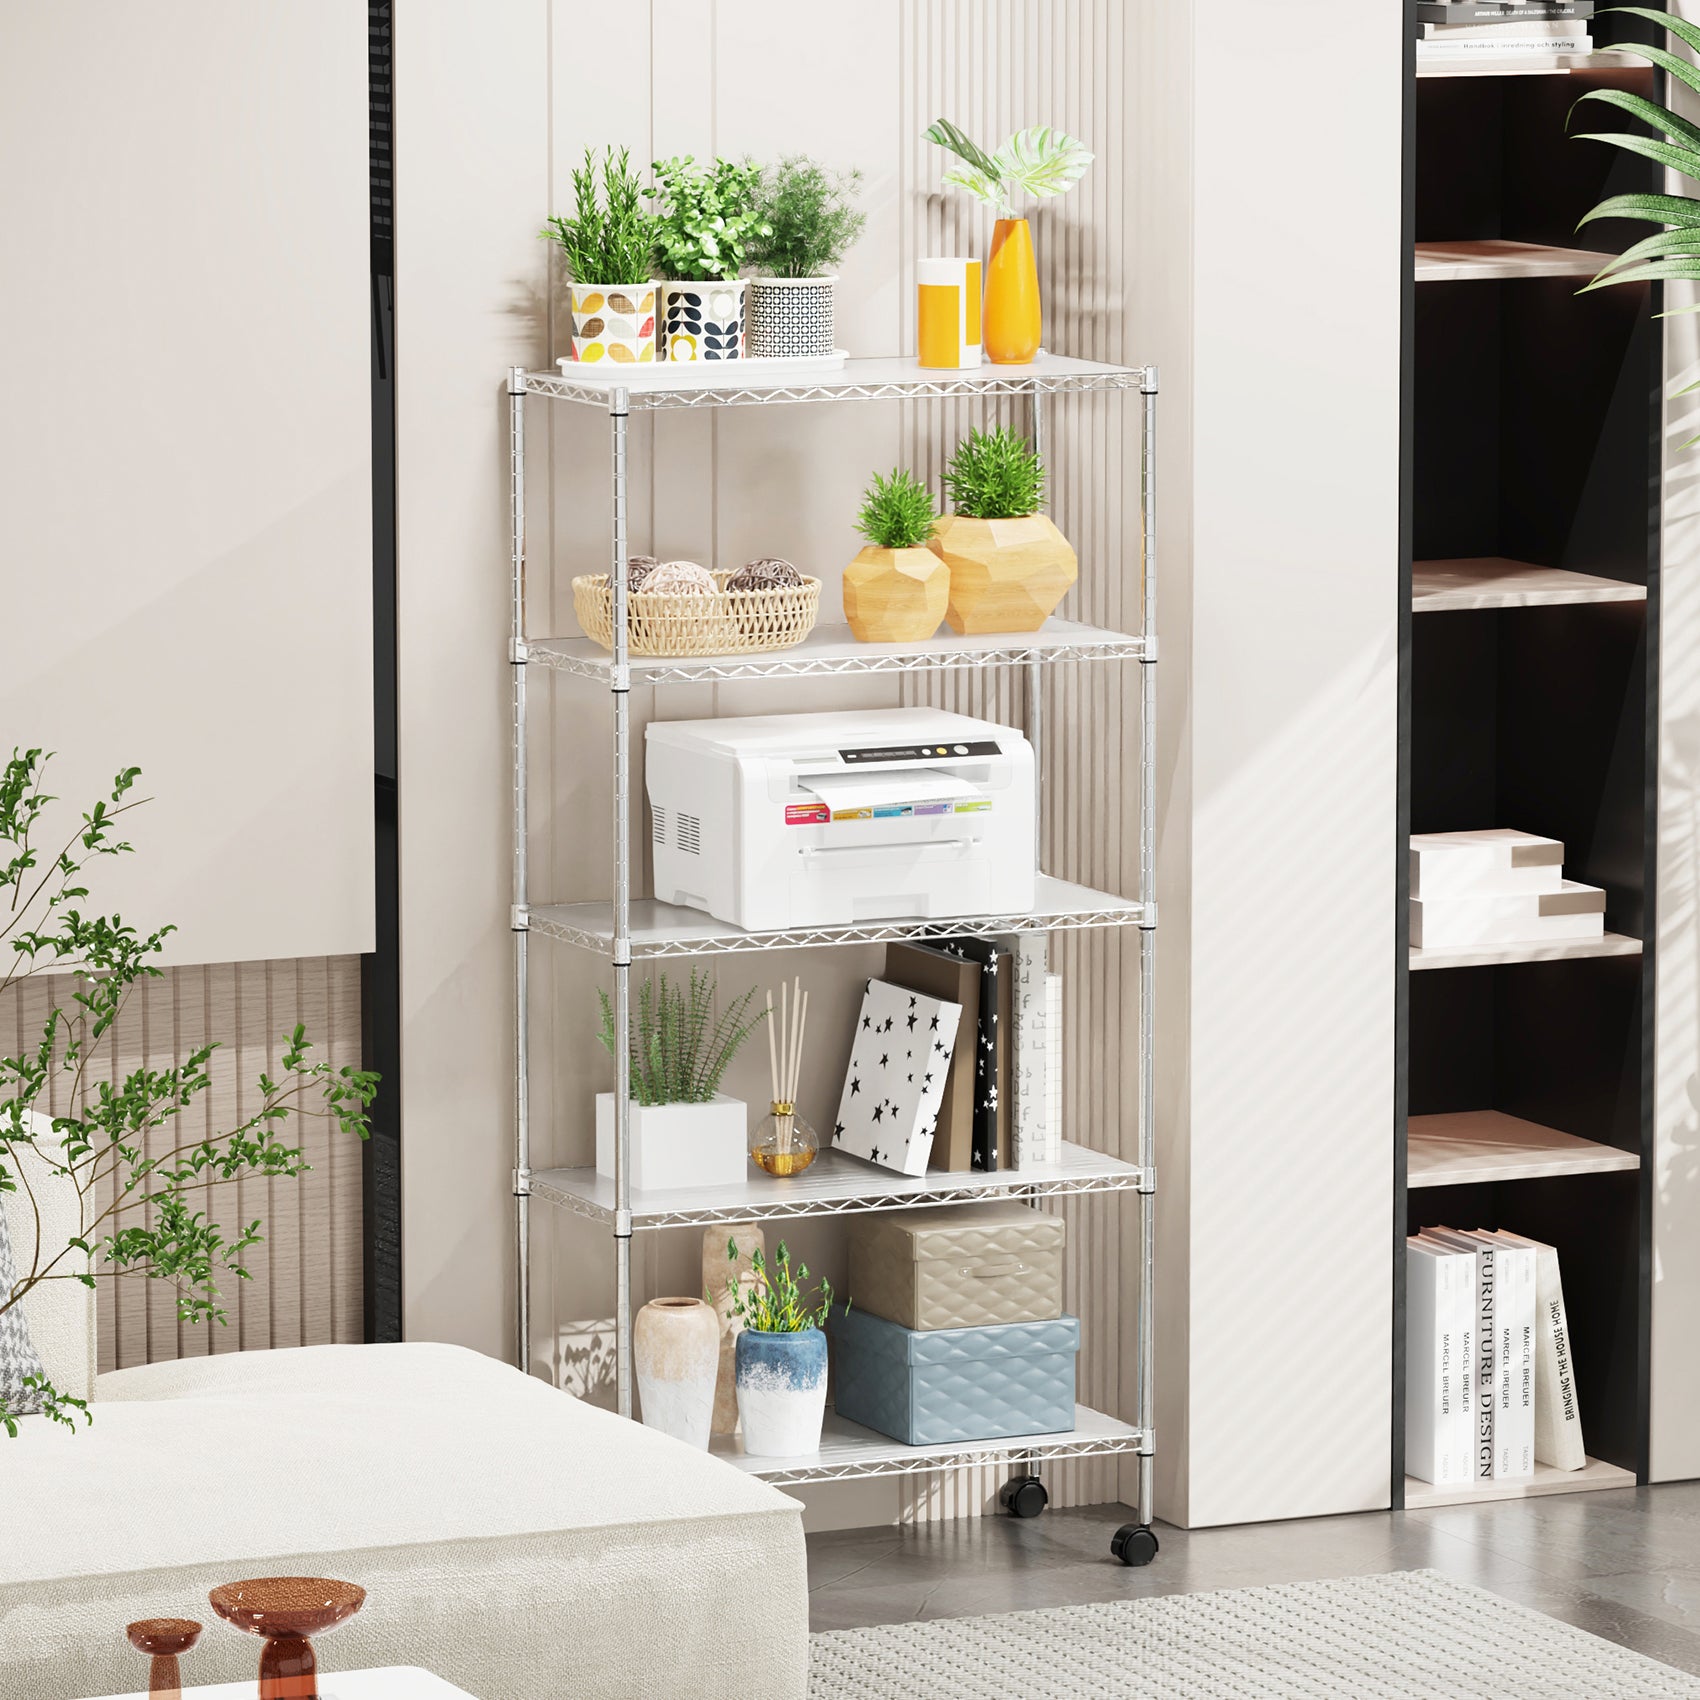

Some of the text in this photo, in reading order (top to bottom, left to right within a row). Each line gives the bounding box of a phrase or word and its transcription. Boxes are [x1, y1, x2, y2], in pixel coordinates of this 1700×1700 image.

[1551, 41, 1575, 49] styling
[1442, 1333, 1450, 1373] MARCEL
[1462, 1331, 1470, 1413] MARCEL BREUER
[1480, 1250, 1494, 1477] FURNITURE DESIGN
[1502, 1328, 1510, 1409] MARCEL BREUER
[1522, 1326, 1530, 1407] MARCEL BREUER
[1549, 1299, 1575, 1421] BRINGING THE HOUSE HOME
